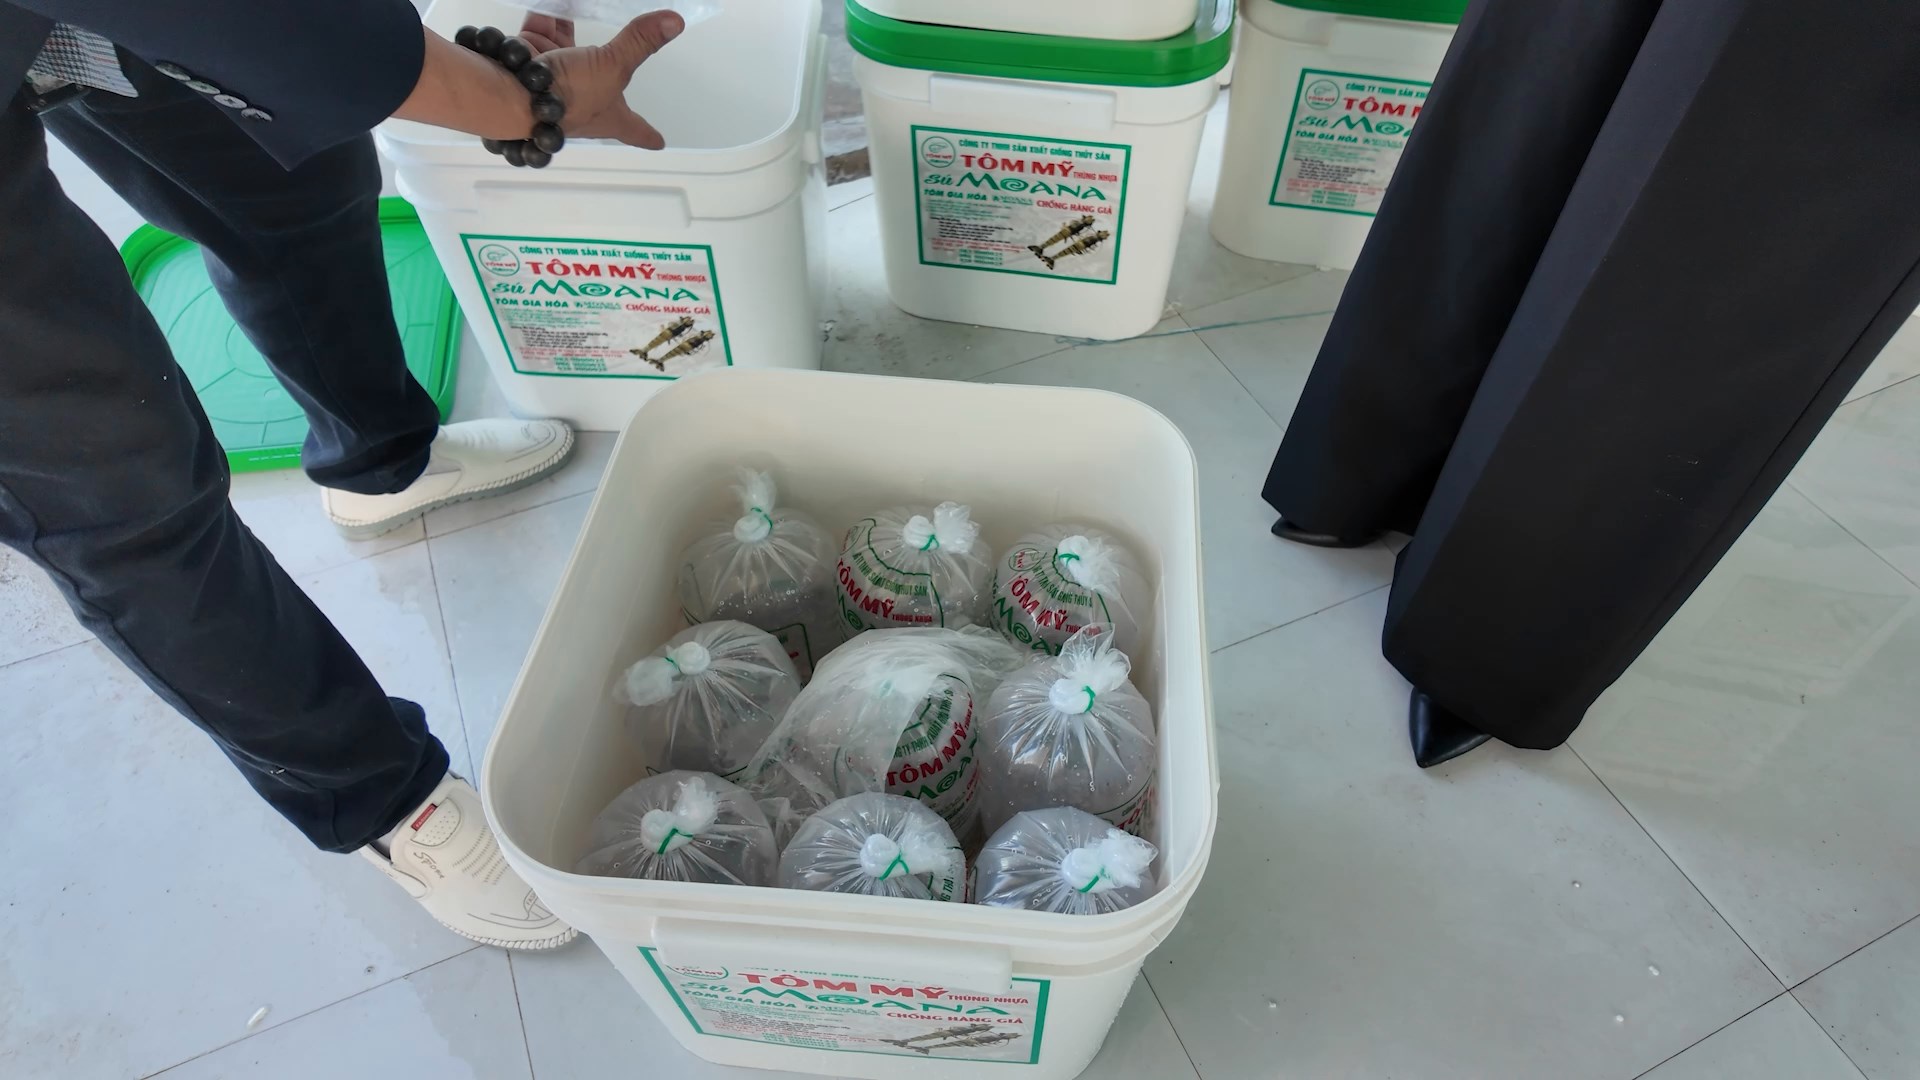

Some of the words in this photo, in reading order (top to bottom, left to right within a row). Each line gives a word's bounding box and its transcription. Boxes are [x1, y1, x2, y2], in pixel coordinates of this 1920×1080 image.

[1343, 96, 1406, 117] TÔM
[960, 152, 1024, 172] TÔM
[1031, 160, 1075, 178] MỸ
[955, 171, 1107, 201] MOANA
[525, 258, 601, 277] TÔM
[607, 263, 656, 280] MỸ
[530, 279, 701, 302] MOANA
[858, 594, 895, 619] MỸ
[1011, 575, 1041, 617] ÔM
[885, 757, 944, 787] TÔM
[941, 721, 968, 763] MỸ
[736, 972, 858, 993] TÔM
[869, 984, 949, 1000] MỸ
[946, 994, 990, 1003] THÙNG
[993, 996, 1030, 1005] NHỰA
[736, 986, 1011, 1016] MOANA
